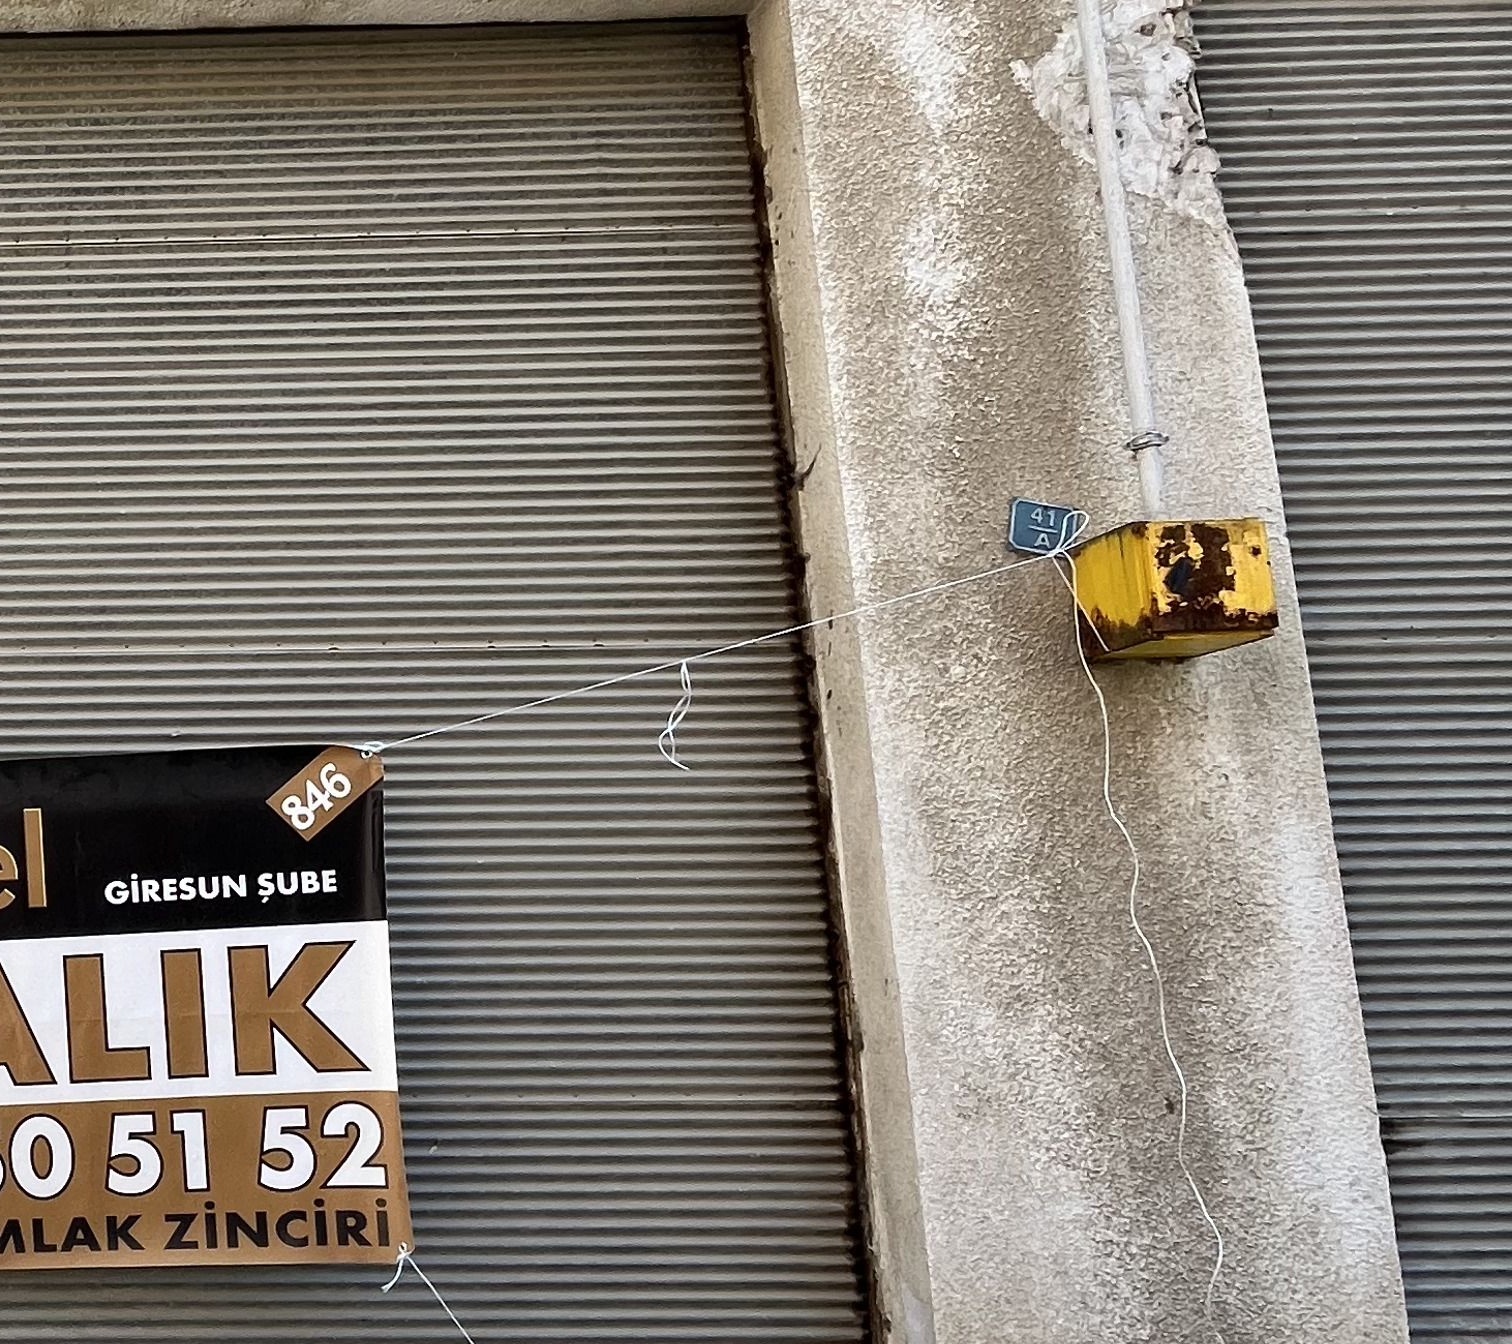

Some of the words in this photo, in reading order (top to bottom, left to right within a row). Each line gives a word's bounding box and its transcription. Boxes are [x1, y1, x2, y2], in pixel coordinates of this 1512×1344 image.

[1030, 507, 1056, 527] 41
[1033, 533, 1052, 548] A
[280, 762, 353, 832] 846
[104, 873, 247, 905] GİRESUN
[257, 869, 338, 904] ŞUBE
[104, 1111, 210, 1195] 51
[257, 1101, 390, 1193] 52
[163, 1197, 391, 1250] ZİNCİRİ
